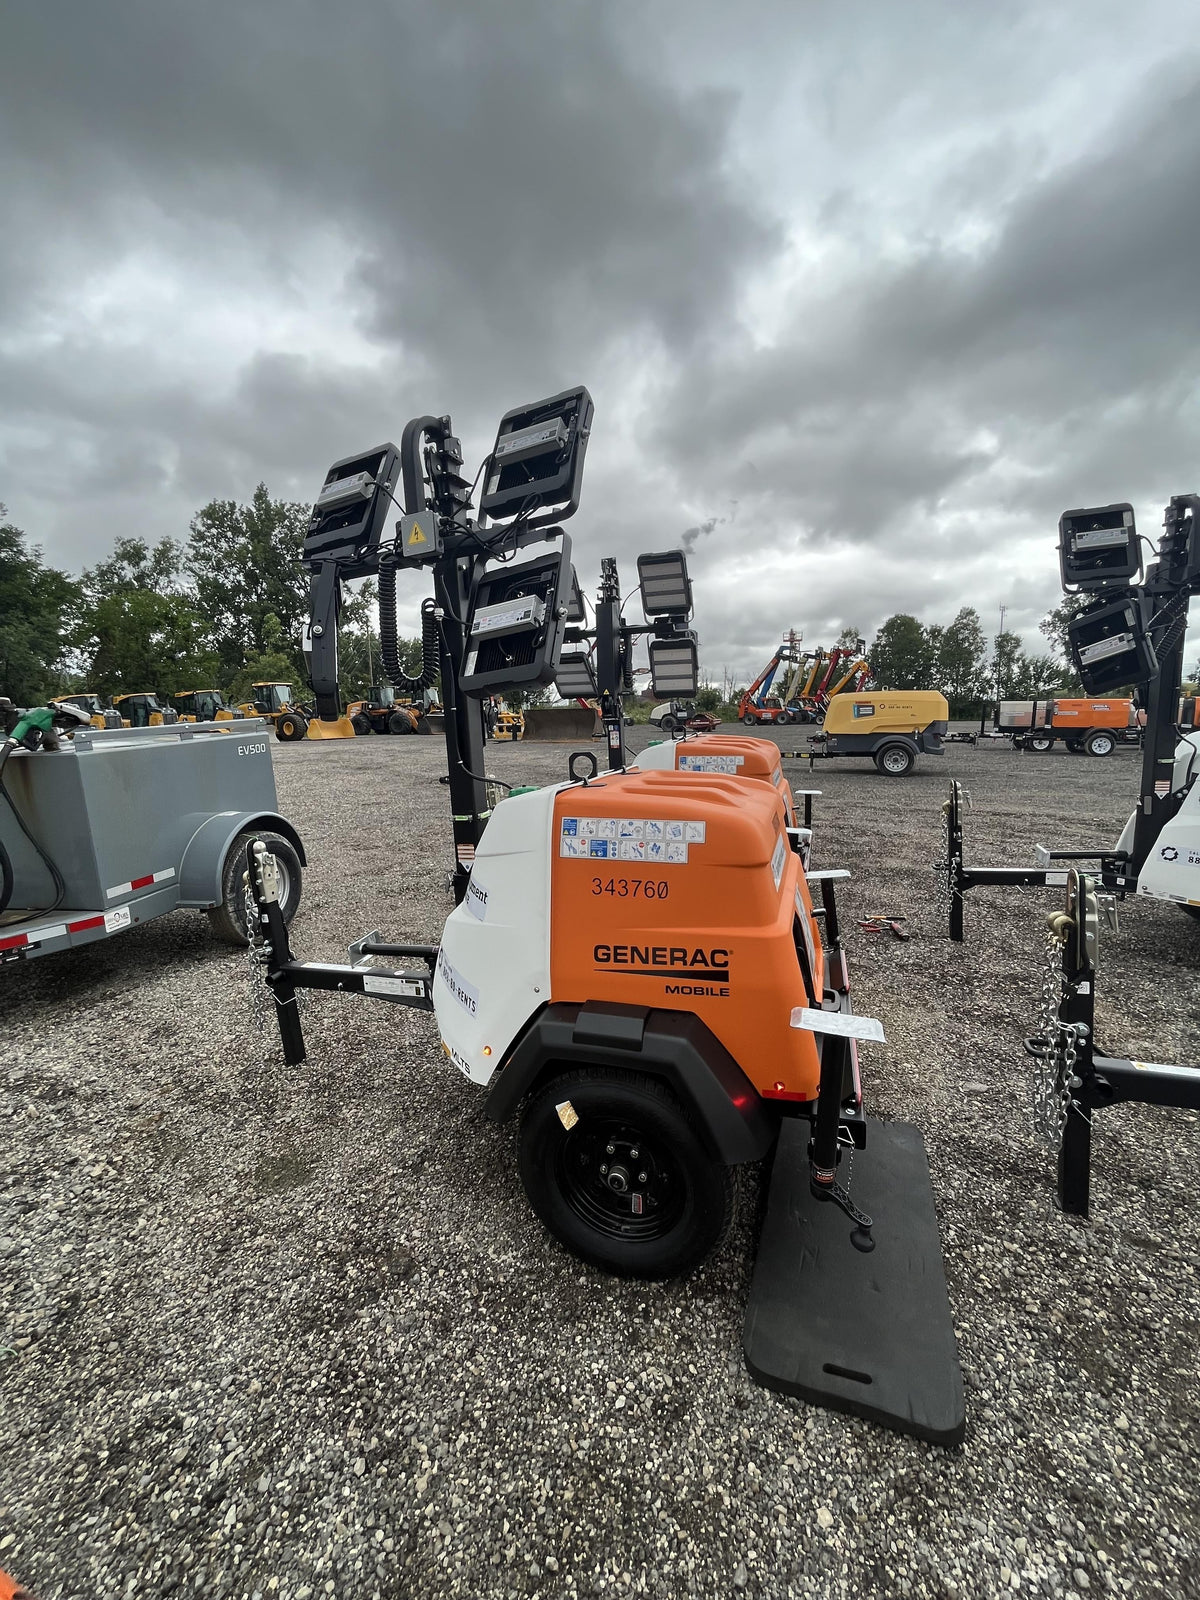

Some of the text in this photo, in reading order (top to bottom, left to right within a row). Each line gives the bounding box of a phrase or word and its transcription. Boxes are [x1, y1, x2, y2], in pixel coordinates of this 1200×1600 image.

[238, 743, 266, 756] EV500
[591, 877, 669, 899] 343760
[593, 944, 729, 968] GENERAC
[665, 985, 730, 997] MOBILE
